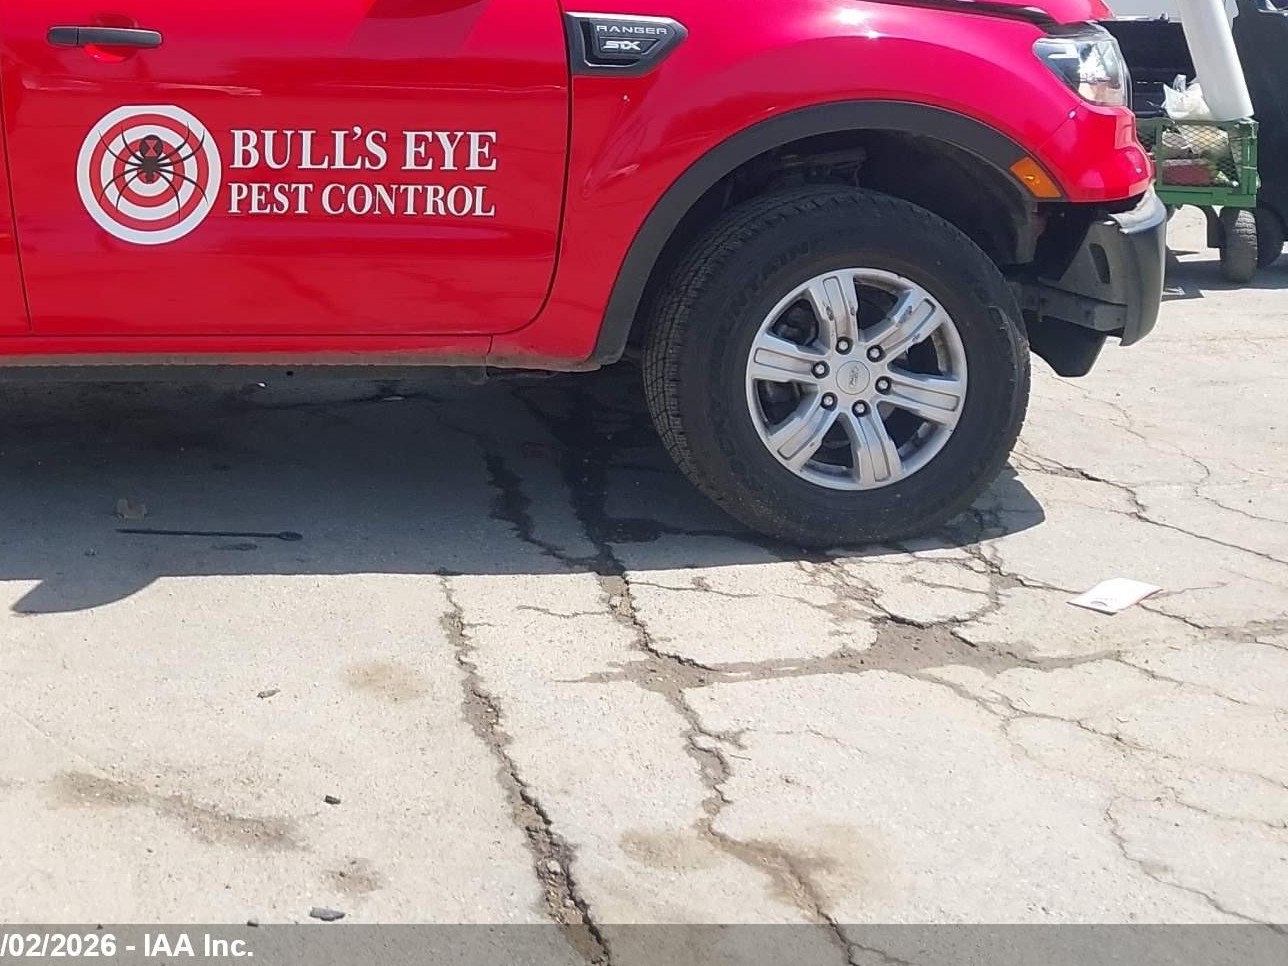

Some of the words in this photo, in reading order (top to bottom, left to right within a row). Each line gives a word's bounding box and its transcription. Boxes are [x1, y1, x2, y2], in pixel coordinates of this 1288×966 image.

[596, 24, 668, 35] RANGER
[602, 40, 641, 51] STX
[229, 126, 387, 170] BULL'S
[401, 131, 497, 171] EYE
[228, 182, 313, 214] PEST
[321, 183, 495, 217] CONTROL
